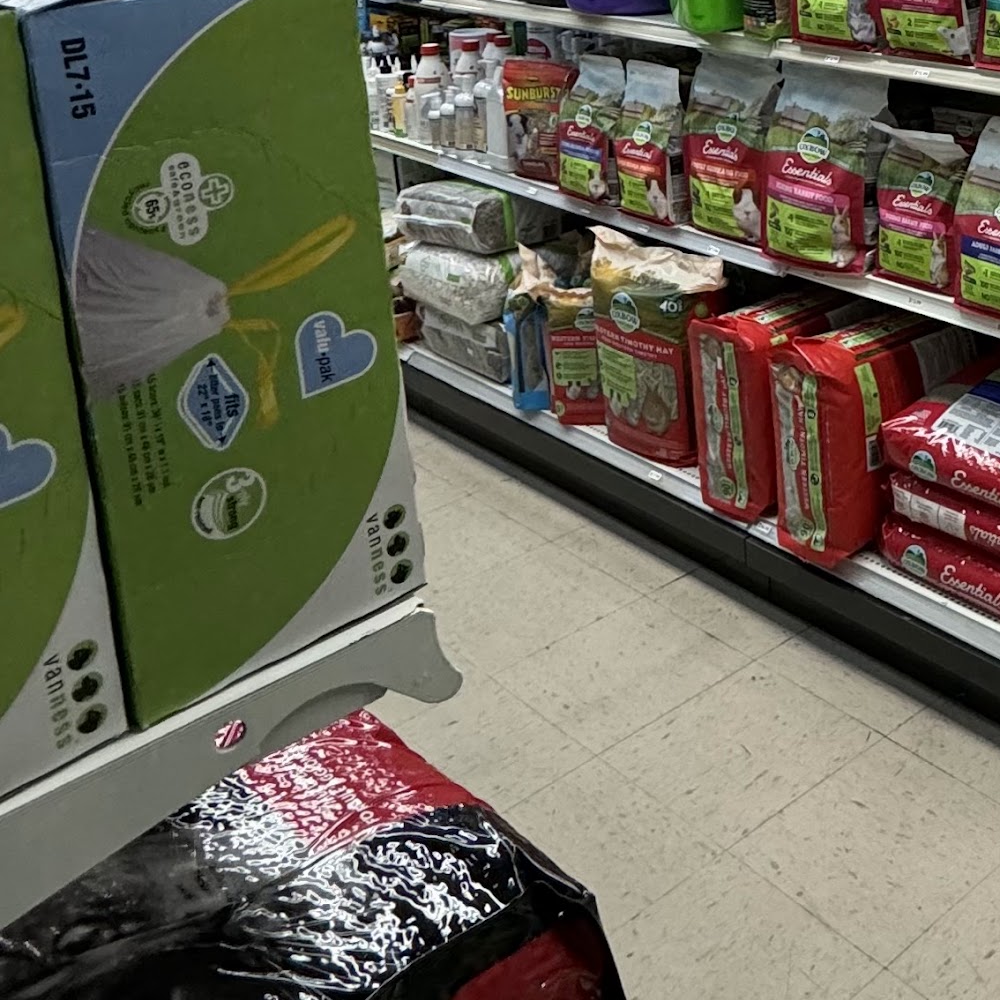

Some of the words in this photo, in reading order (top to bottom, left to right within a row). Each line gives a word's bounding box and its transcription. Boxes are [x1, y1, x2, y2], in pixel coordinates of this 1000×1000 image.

[507, 86, 561, 101] SUNBURST
[703, 139, 739, 162] Essentials
[781, 157, 833, 186] Essentials
[177, 160, 200, 237] econess
[815, 193, 834, 203] FOOD
[892, 194, 933, 215] Essentials
[620, 336, 654, 350] TIMOTHY
[656, 346, 674, 356] HAY
[224, 393, 241, 418] fits
[226, 472, 255, 493] 3
[226, 495, 239, 531] strong
[365, 513, 387, 597] vanness
[42, 652, 72, 751] vanness
